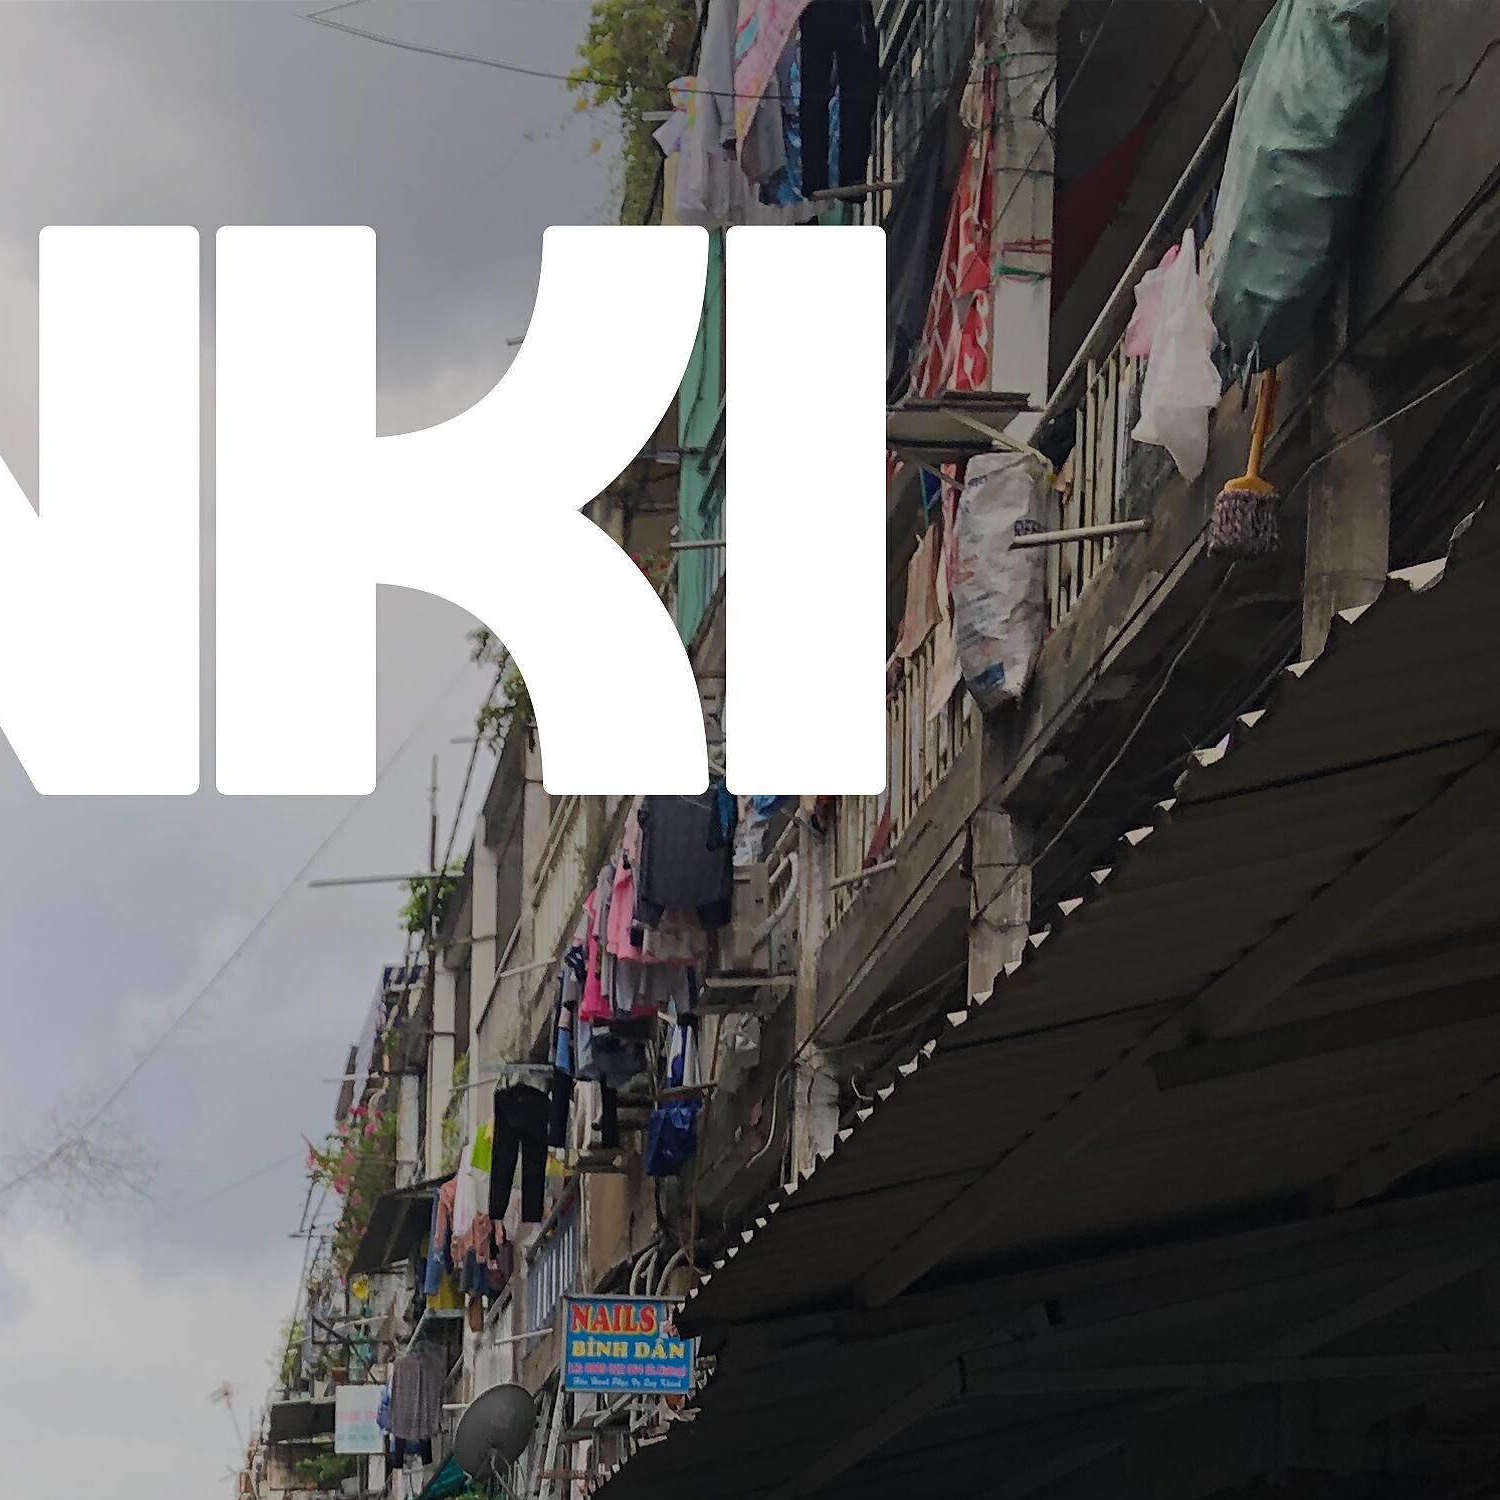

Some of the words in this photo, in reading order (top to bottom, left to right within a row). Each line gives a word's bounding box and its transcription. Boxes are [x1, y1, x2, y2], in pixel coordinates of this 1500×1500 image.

[571, 1303, 657, 1335] NAILS
[572, 1336, 628, 1357] BÌNH
[634, 1338, 685, 1359] DÂN
